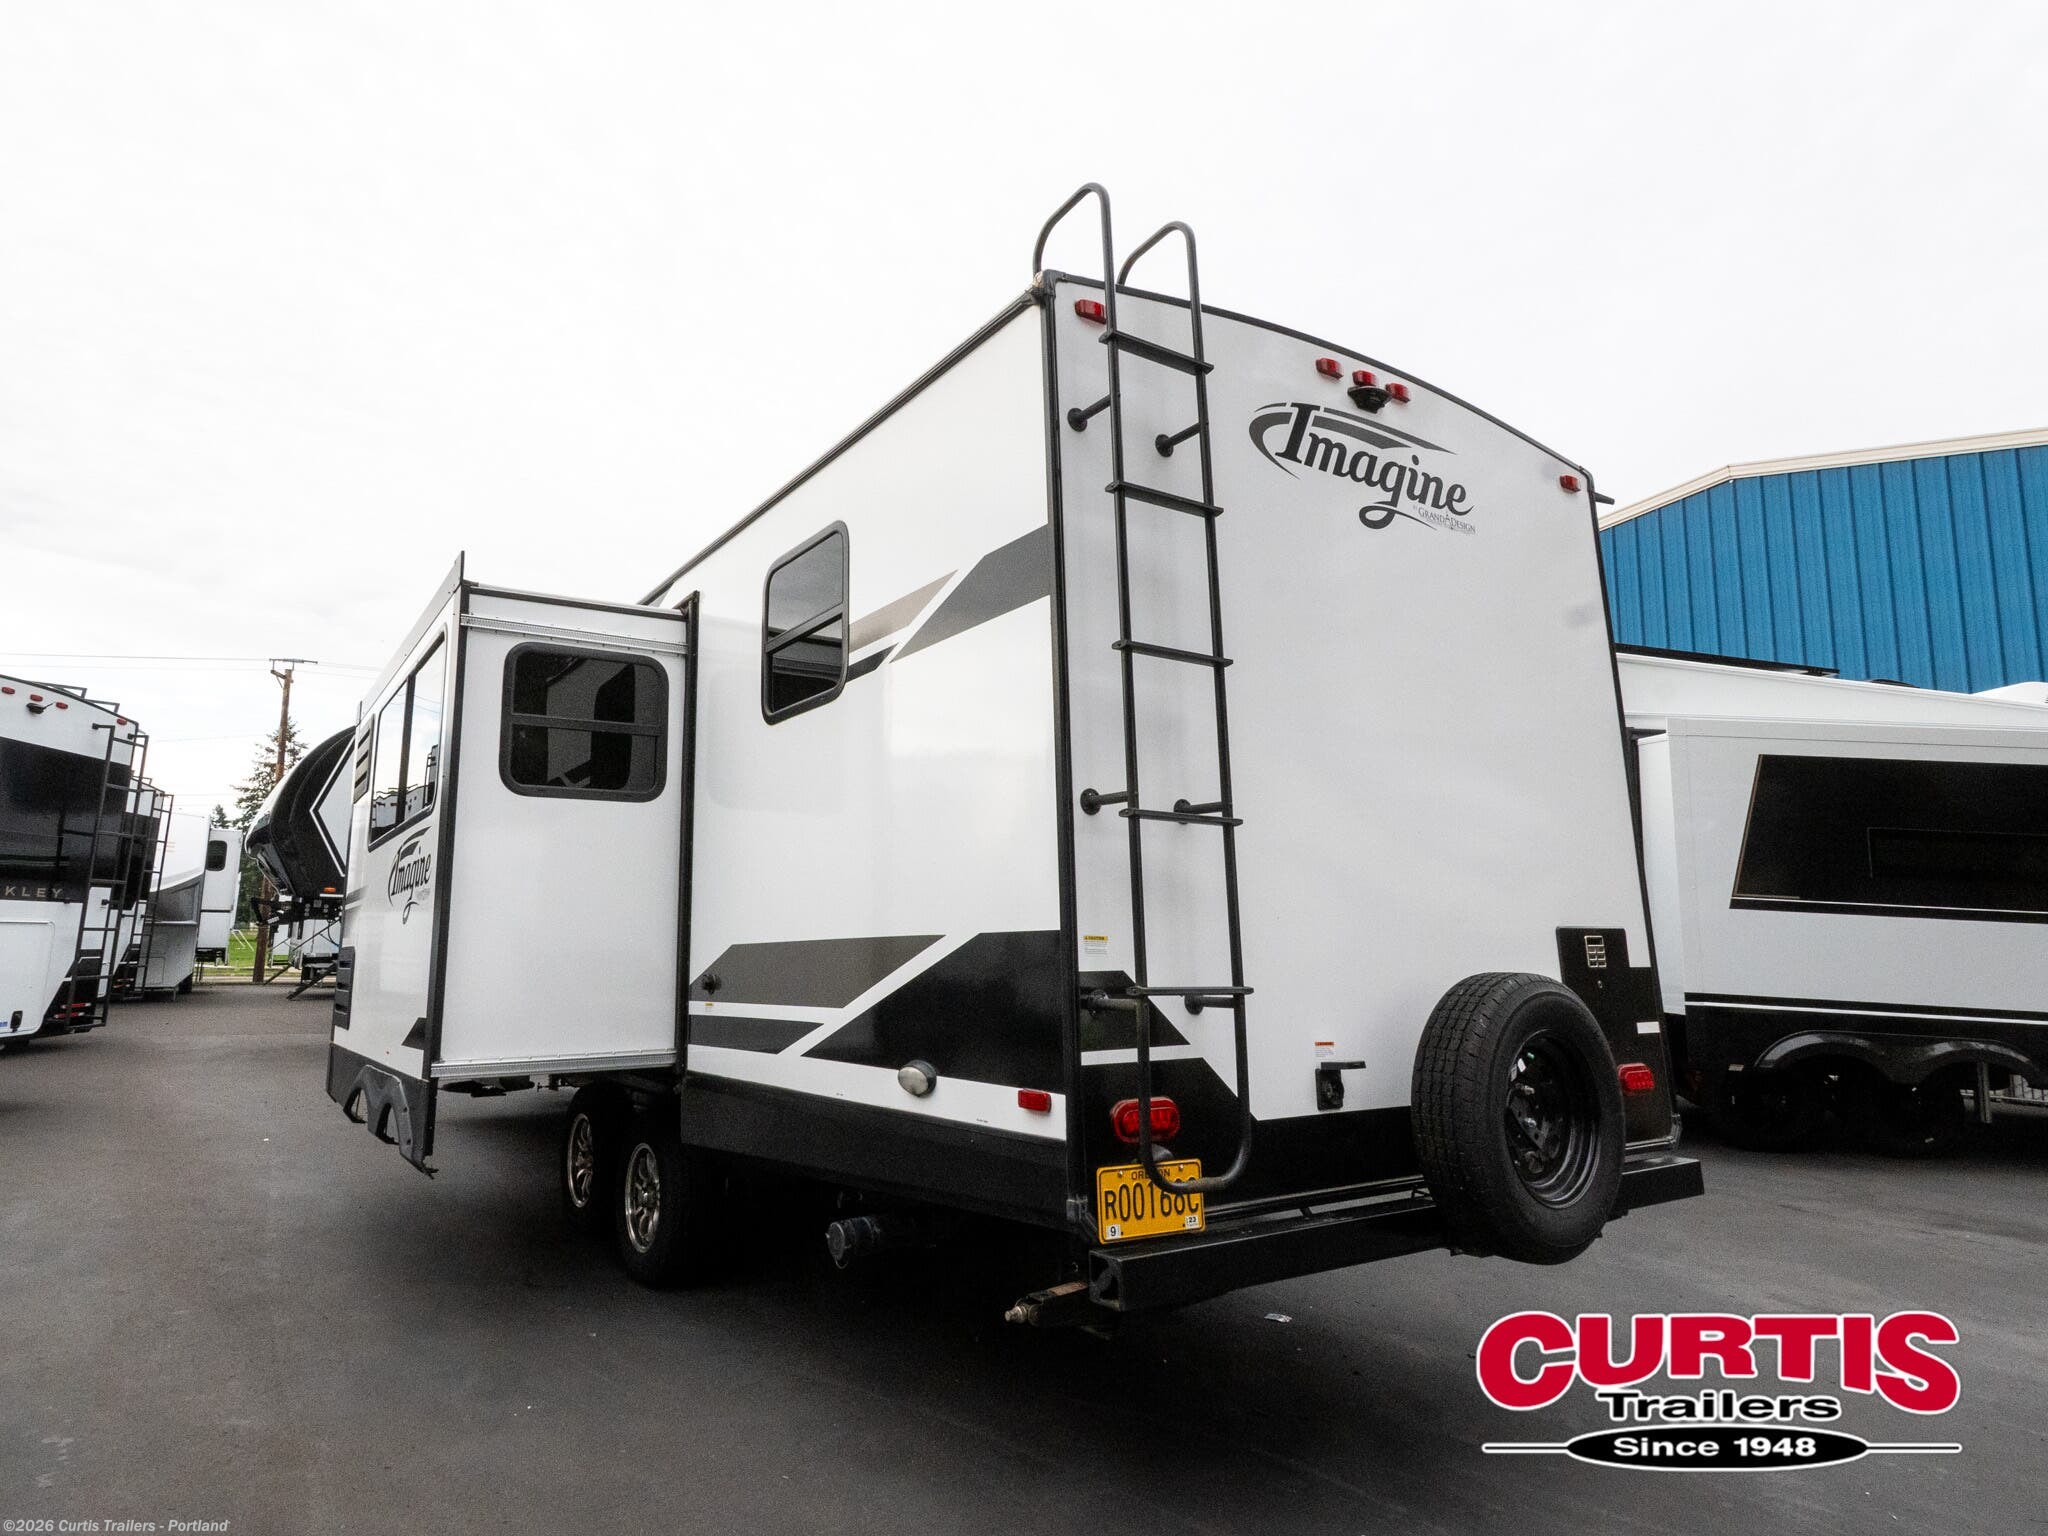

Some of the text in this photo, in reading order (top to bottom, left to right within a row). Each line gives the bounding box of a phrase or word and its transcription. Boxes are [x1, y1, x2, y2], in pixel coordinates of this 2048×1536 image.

[1275, 402, 1475, 530] Imagine
[391, 846, 432, 925] Imagine
[4, 886, 63, 899] KLEY
[1131, 1168, 1171, 1181] ORN
[1110, 1226, 1117, 1237] 9
